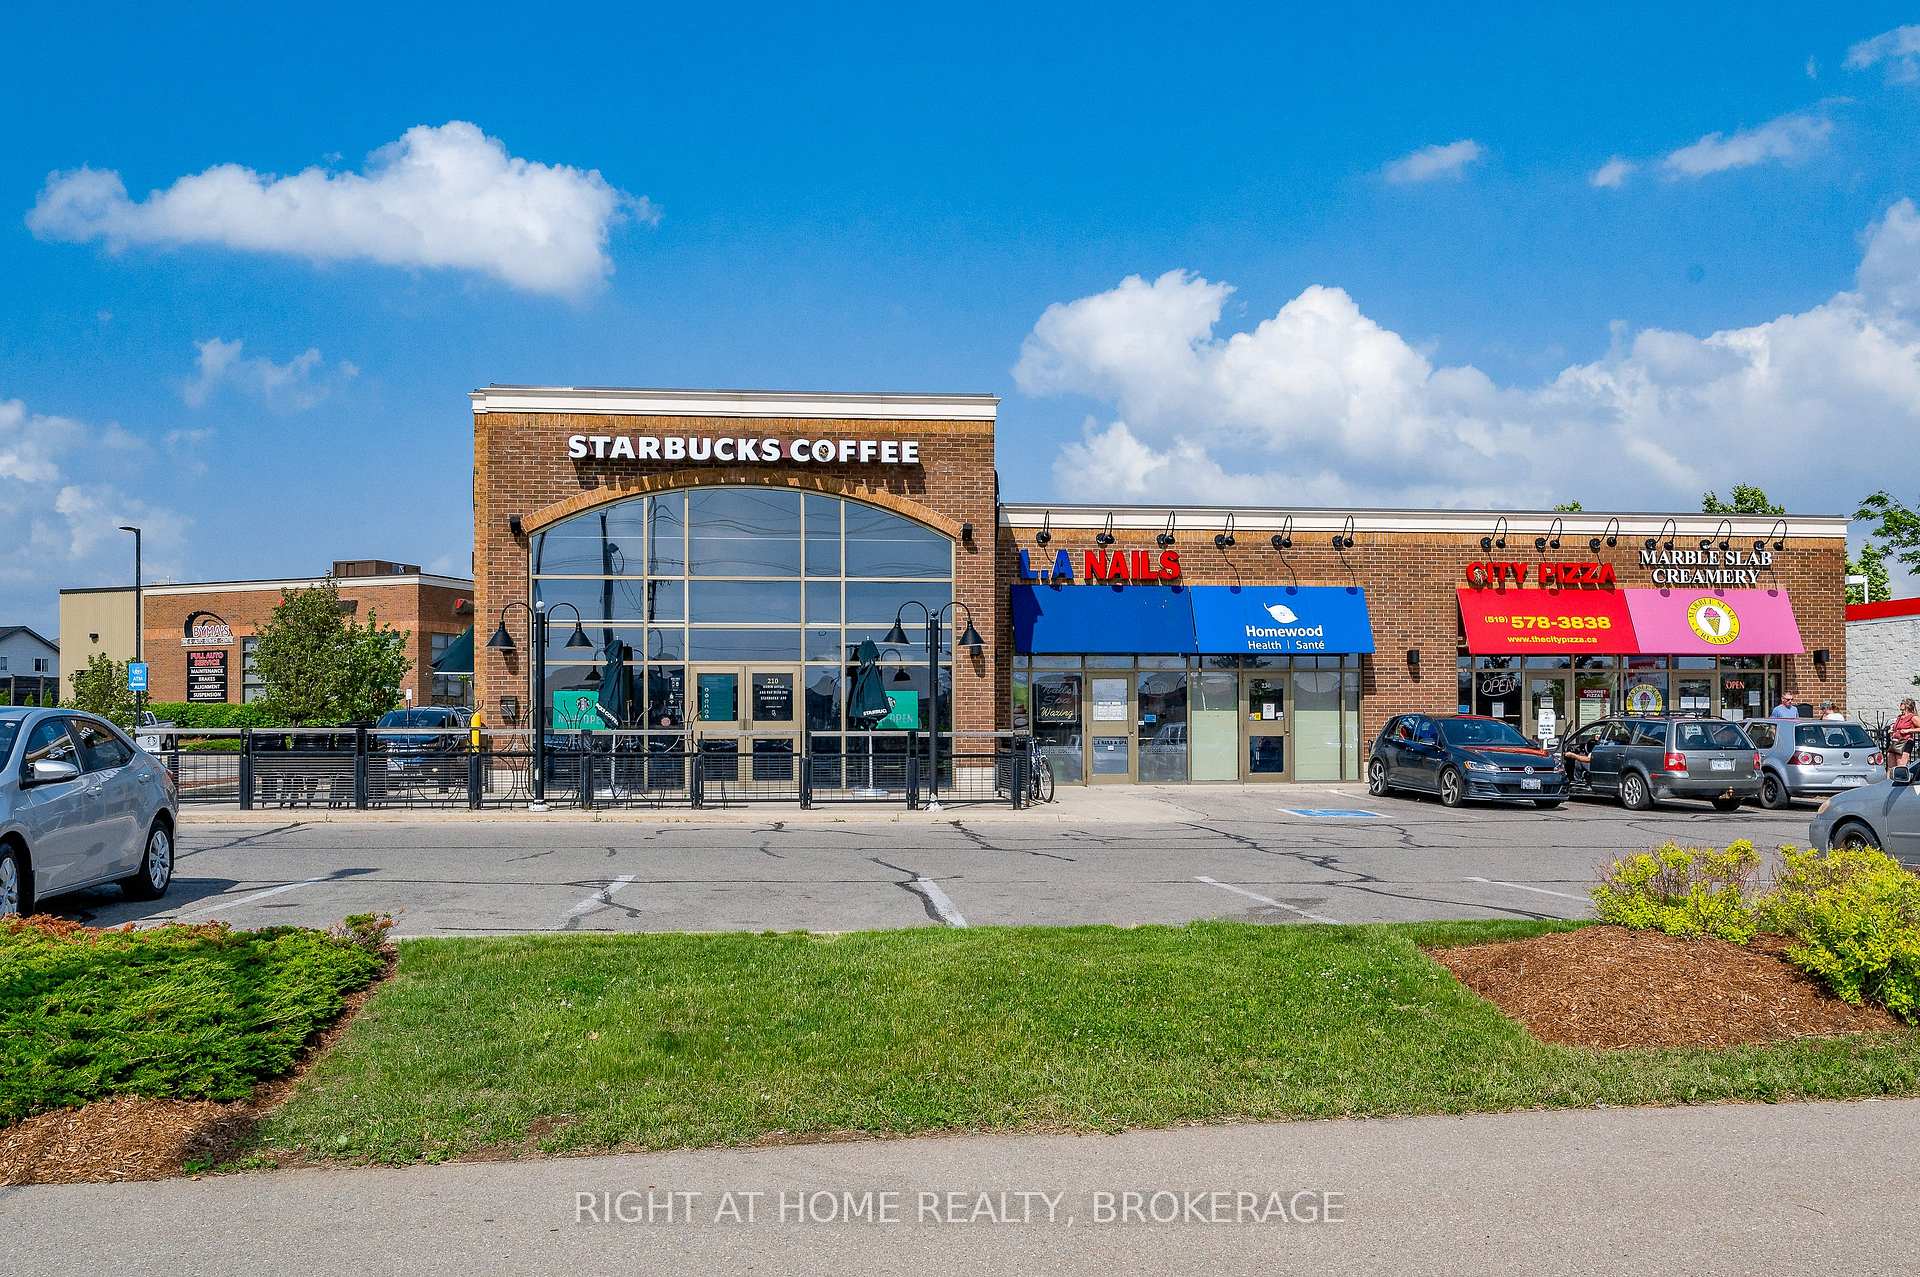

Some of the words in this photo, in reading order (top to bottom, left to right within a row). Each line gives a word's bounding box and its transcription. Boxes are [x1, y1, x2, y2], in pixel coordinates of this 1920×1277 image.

[568, 435, 781, 462] STARBUCKS
[790, 438, 919, 463] COFFEE
[1018, 548, 1074, 580] L.A
[1084, 549, 1182, 580] NAILS
[1640, 550, 1721, 566] MARBLE
[1725, 551, 1773, 566] SLAB
[1466, 561, 1529, 585] CITY
[1538, 562, 1617, 585] PIZZA
[1652, 569, 1761, 584] CREAMERY
[1511, 616, 1612, 630] 578-3838
[1245, 625, 1324, 637] Homewood
[1247, 640, 1282, 650] Health
[1295, 640, 1325, 650] Santé
[1507, 635, 1598, 645] www.thecitypizza.ca
[190, 652, 205, 660] FULL
[206, 652, 224, 660] AUTO
[194, 659, 220, 667] SERVICE
[1482, 679, 1516, 693] OPEN
[1725, 680, 1745, 690] OPEN
[1040, 706, 1074, 718] Waxing
